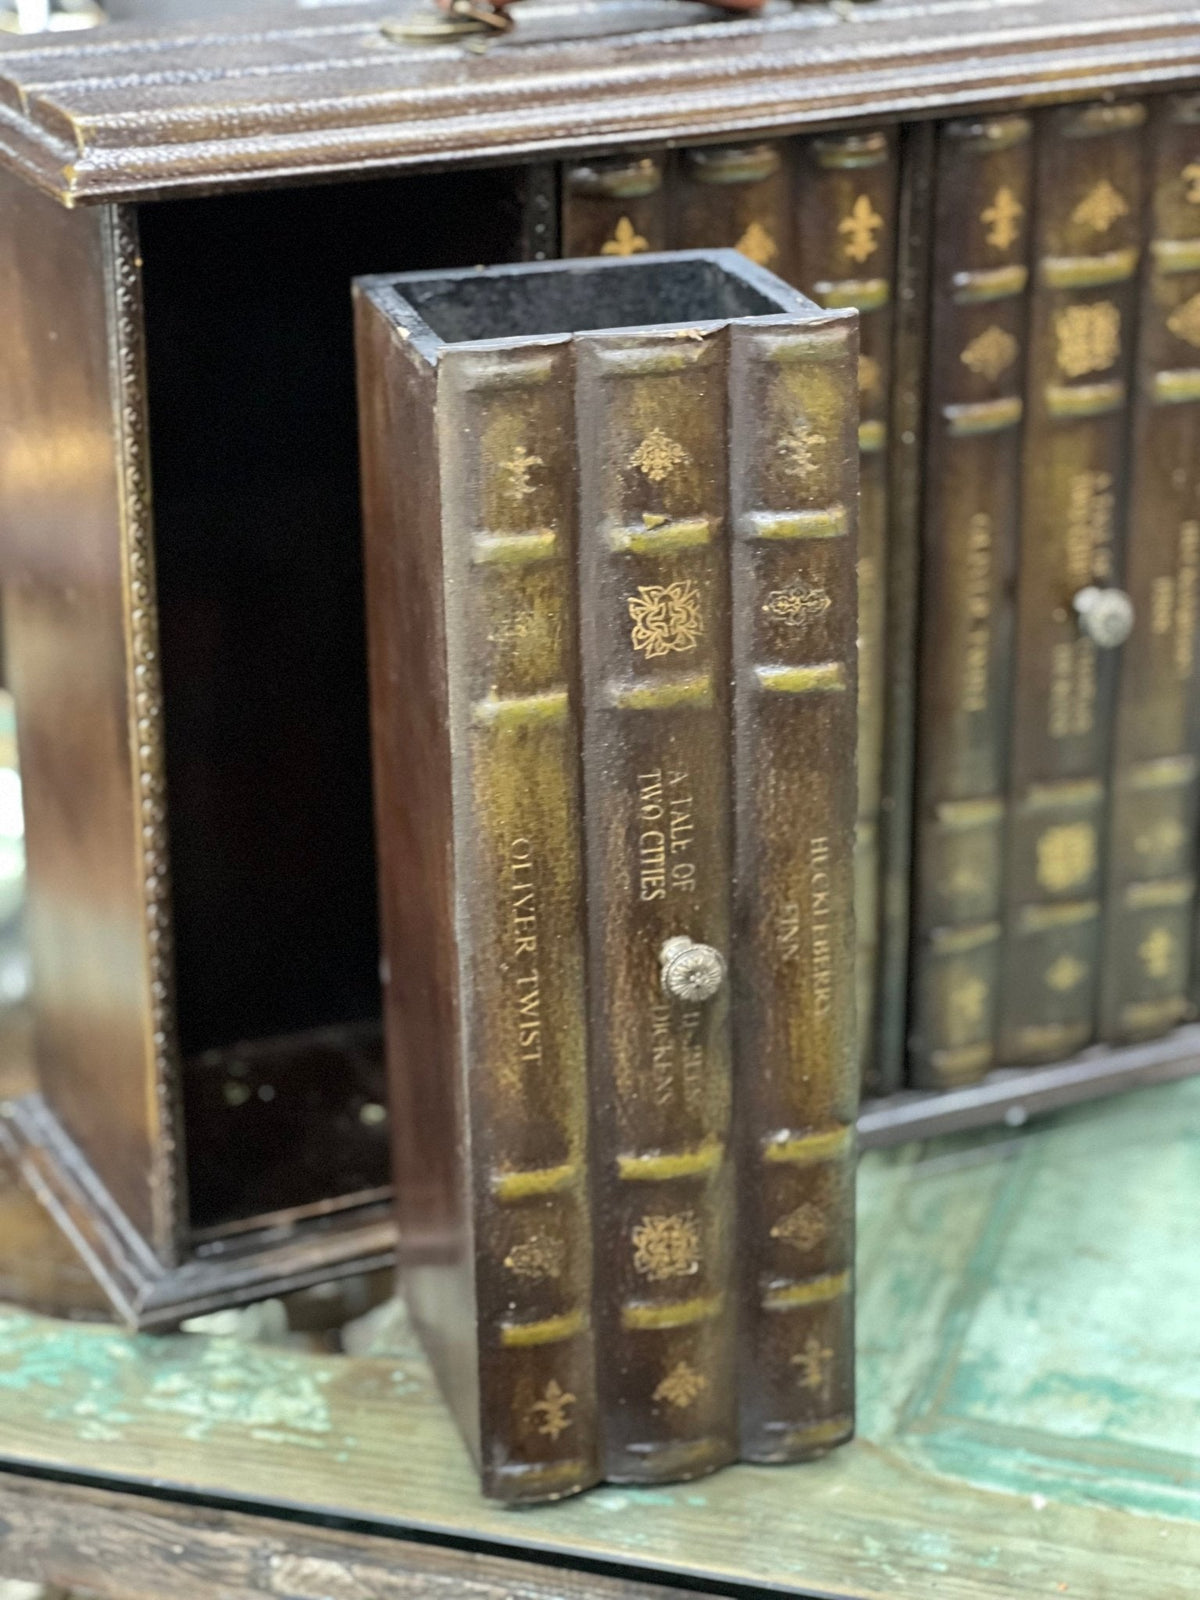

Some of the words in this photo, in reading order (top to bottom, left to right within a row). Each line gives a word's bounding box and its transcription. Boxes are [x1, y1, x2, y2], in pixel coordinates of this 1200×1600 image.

[637, 768, 663, 820] TWO
[667, 769, 688, 786] A
[669, 796, 694, 854] TALE
[511, 837, 536, 956] OLIVER
[640, 831, 666, 901] CITIES
[671, 862, 696, 893] OF
[779, 903, 801, 962] FINN
[811, 836, 833, 1017] HUCKLEBERRY
[516, 969, 543, 1065] TWIST
[653, 1005, 675, 1106] DICKENS
